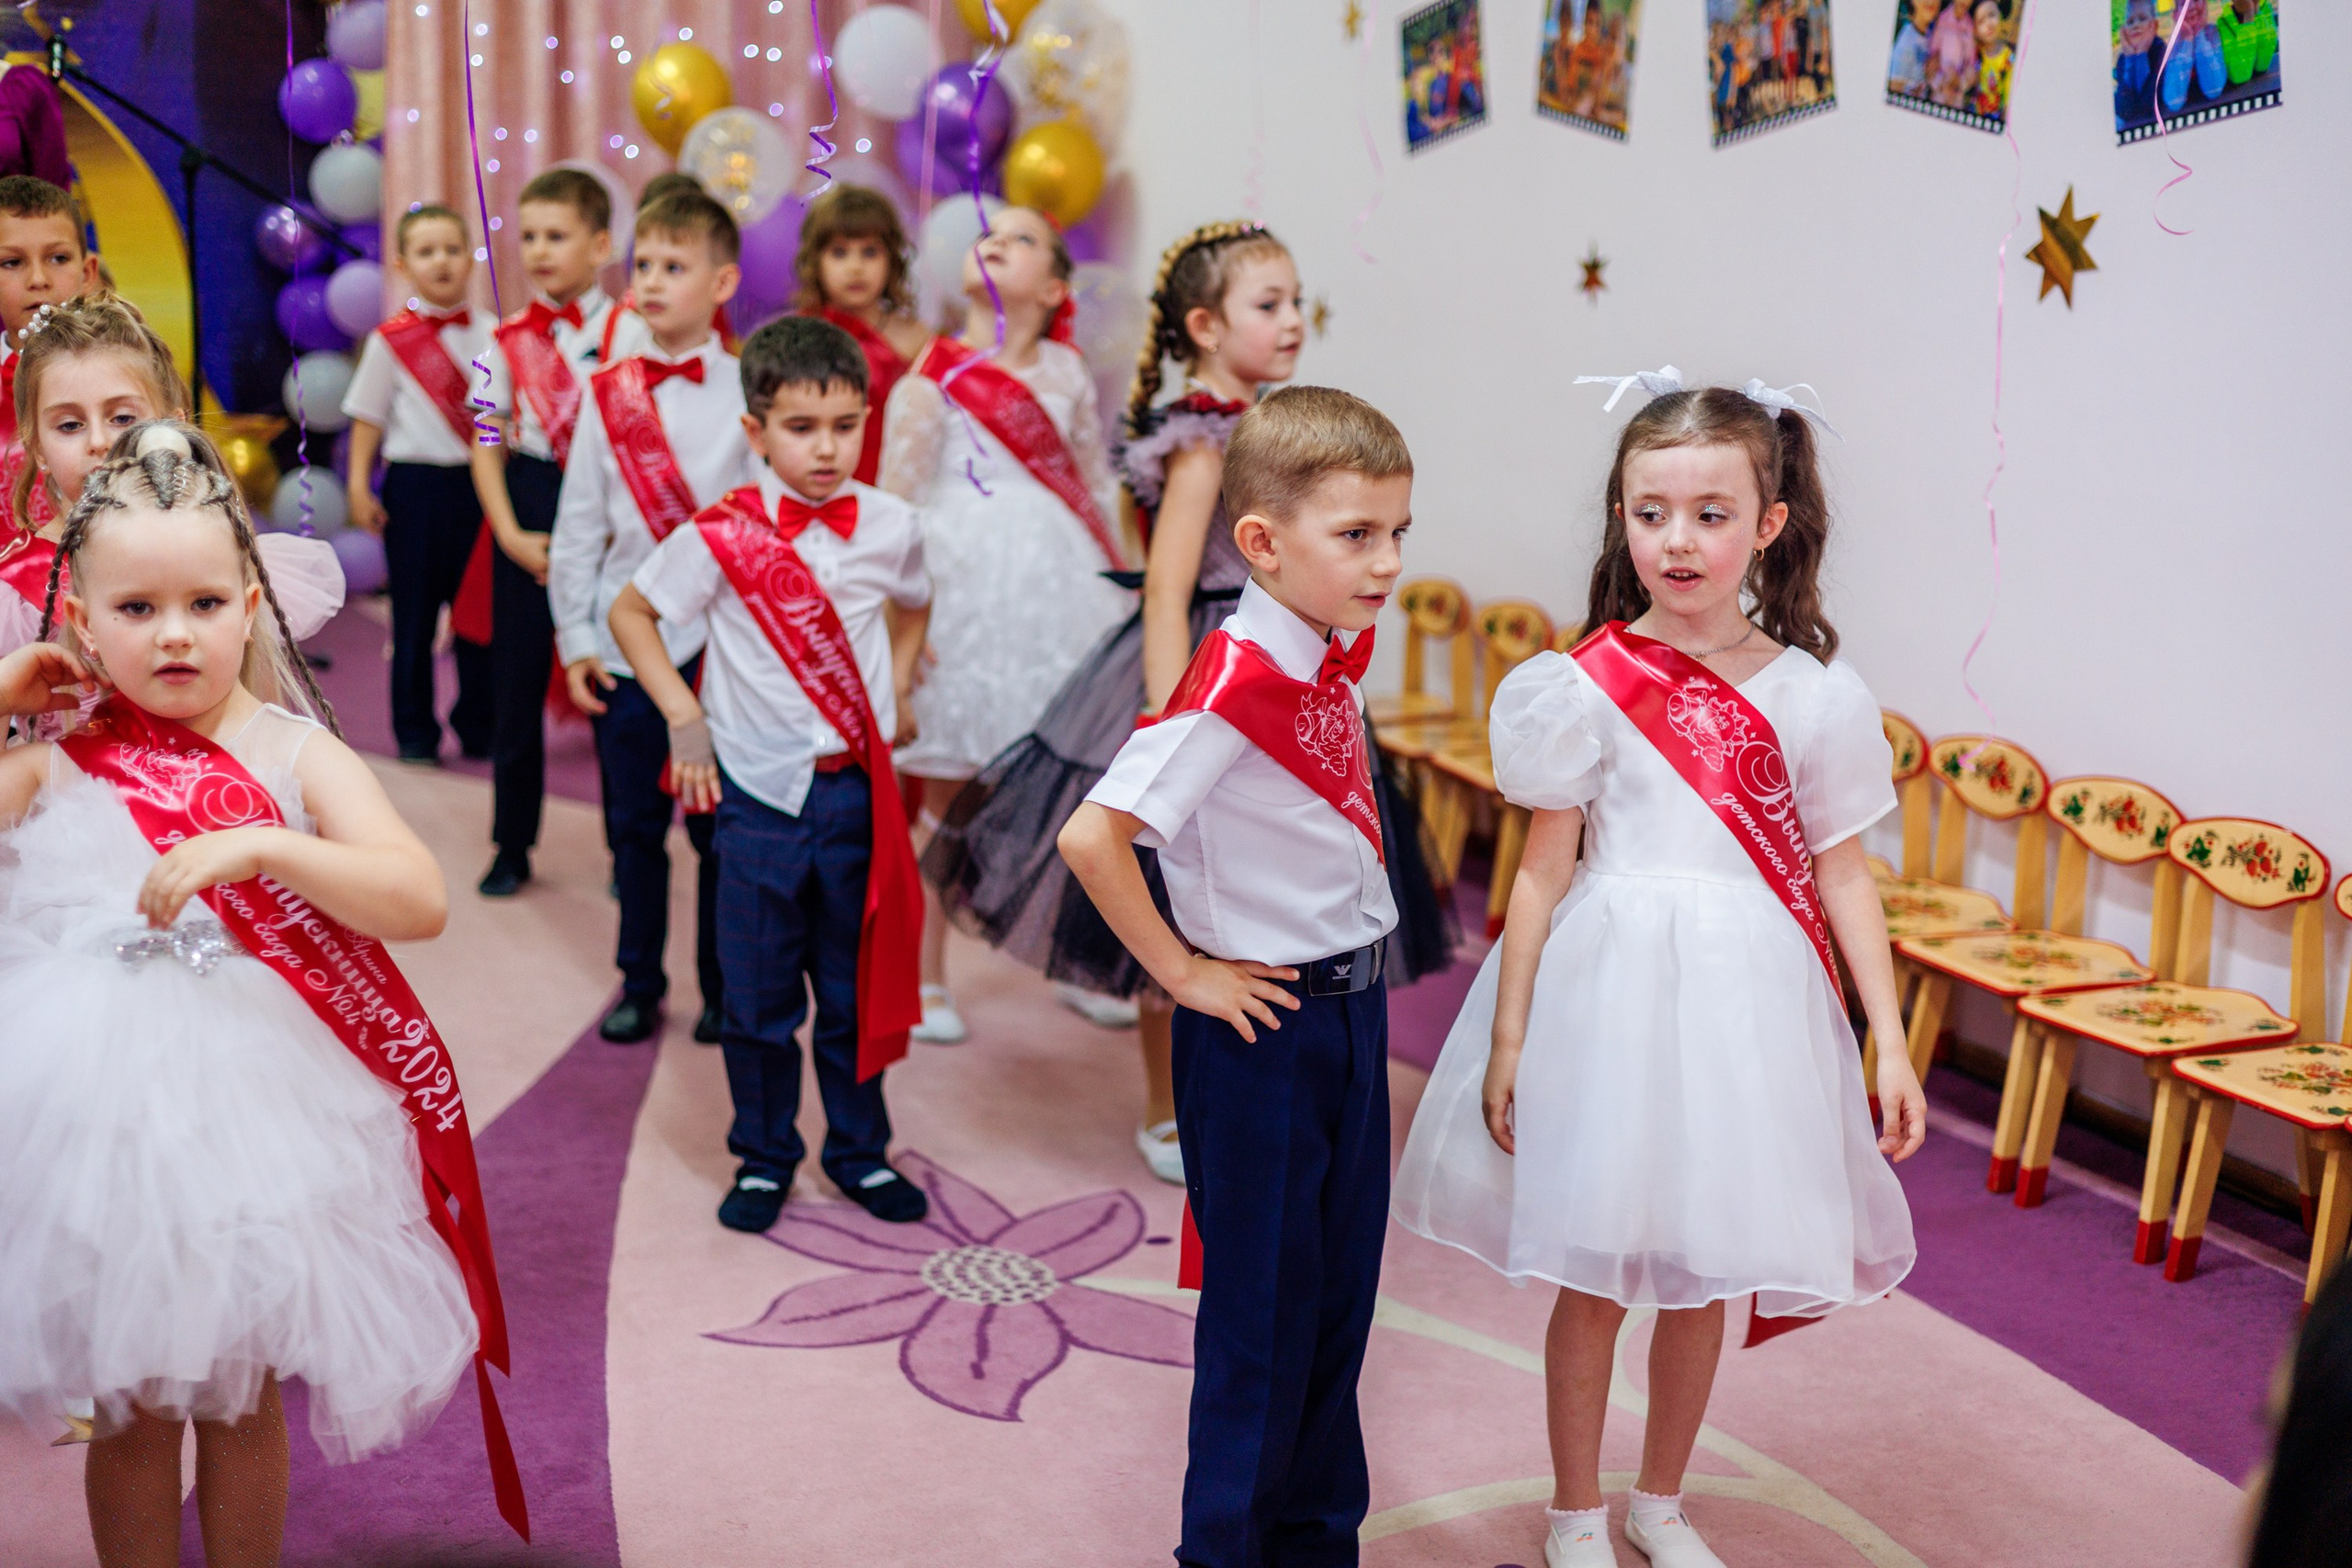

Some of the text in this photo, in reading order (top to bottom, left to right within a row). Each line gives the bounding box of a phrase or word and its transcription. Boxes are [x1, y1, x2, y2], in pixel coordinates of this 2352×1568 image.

[1710, 792, 1787, 876] детского
[1786, 877, 1815, 921] сада
[254, 922, 304, 968] сада
[344, 927, 387, 985] Арина
[379, 1019, 461, 1133] 2024
